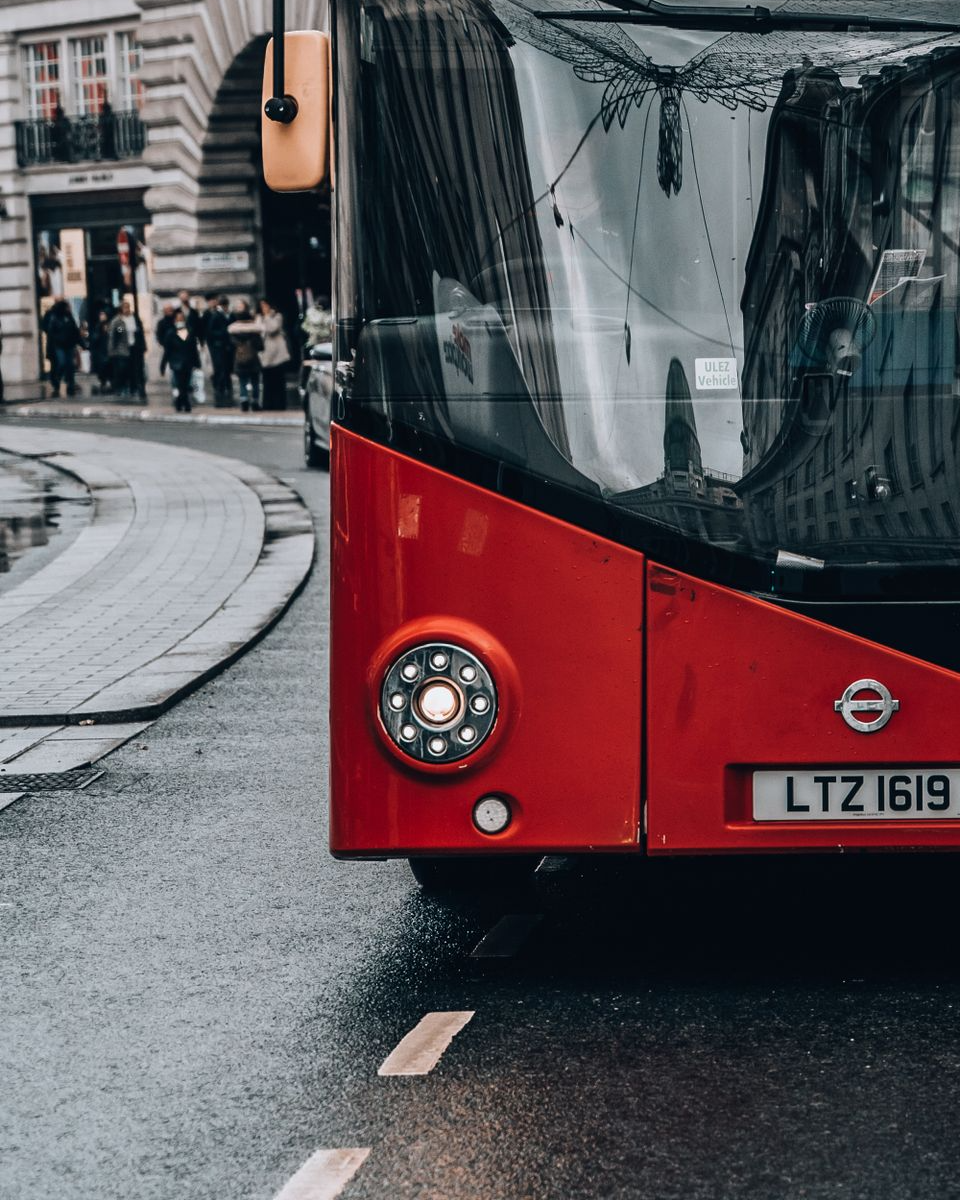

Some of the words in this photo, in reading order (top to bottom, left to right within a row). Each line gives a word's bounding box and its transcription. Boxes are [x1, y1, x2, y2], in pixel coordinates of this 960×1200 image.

[704, 361, 730, 372] ULEZ
[698, 374, 737, 386] Vehicle
[786, 776, 864, 812] LTZ
[877, 775, 950, 811] 1619
